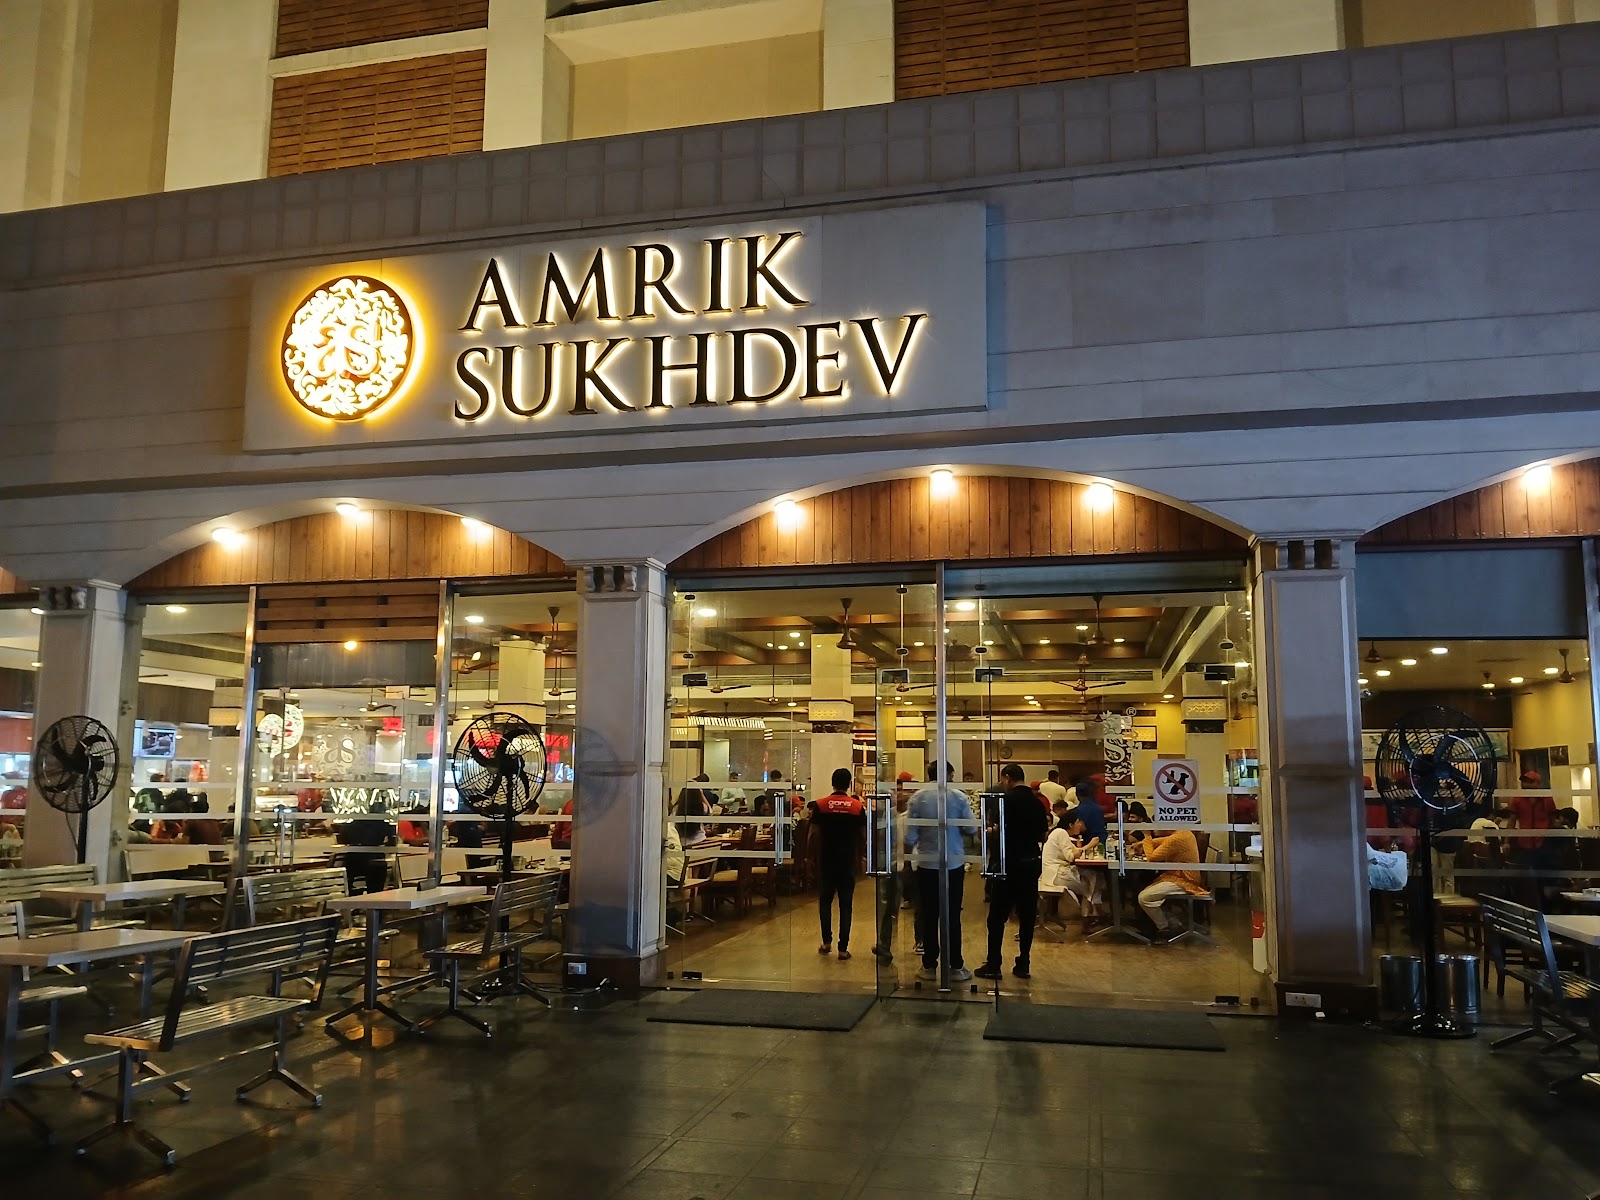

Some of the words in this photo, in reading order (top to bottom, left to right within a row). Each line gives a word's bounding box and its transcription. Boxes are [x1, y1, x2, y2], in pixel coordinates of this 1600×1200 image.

[458, 231, 810, 333] AMRIK
[455, 314, 928, 421] SUKHDEV
[1158, 807, 1174, 815] NO
[1176, 807, 1197, 815] PET
